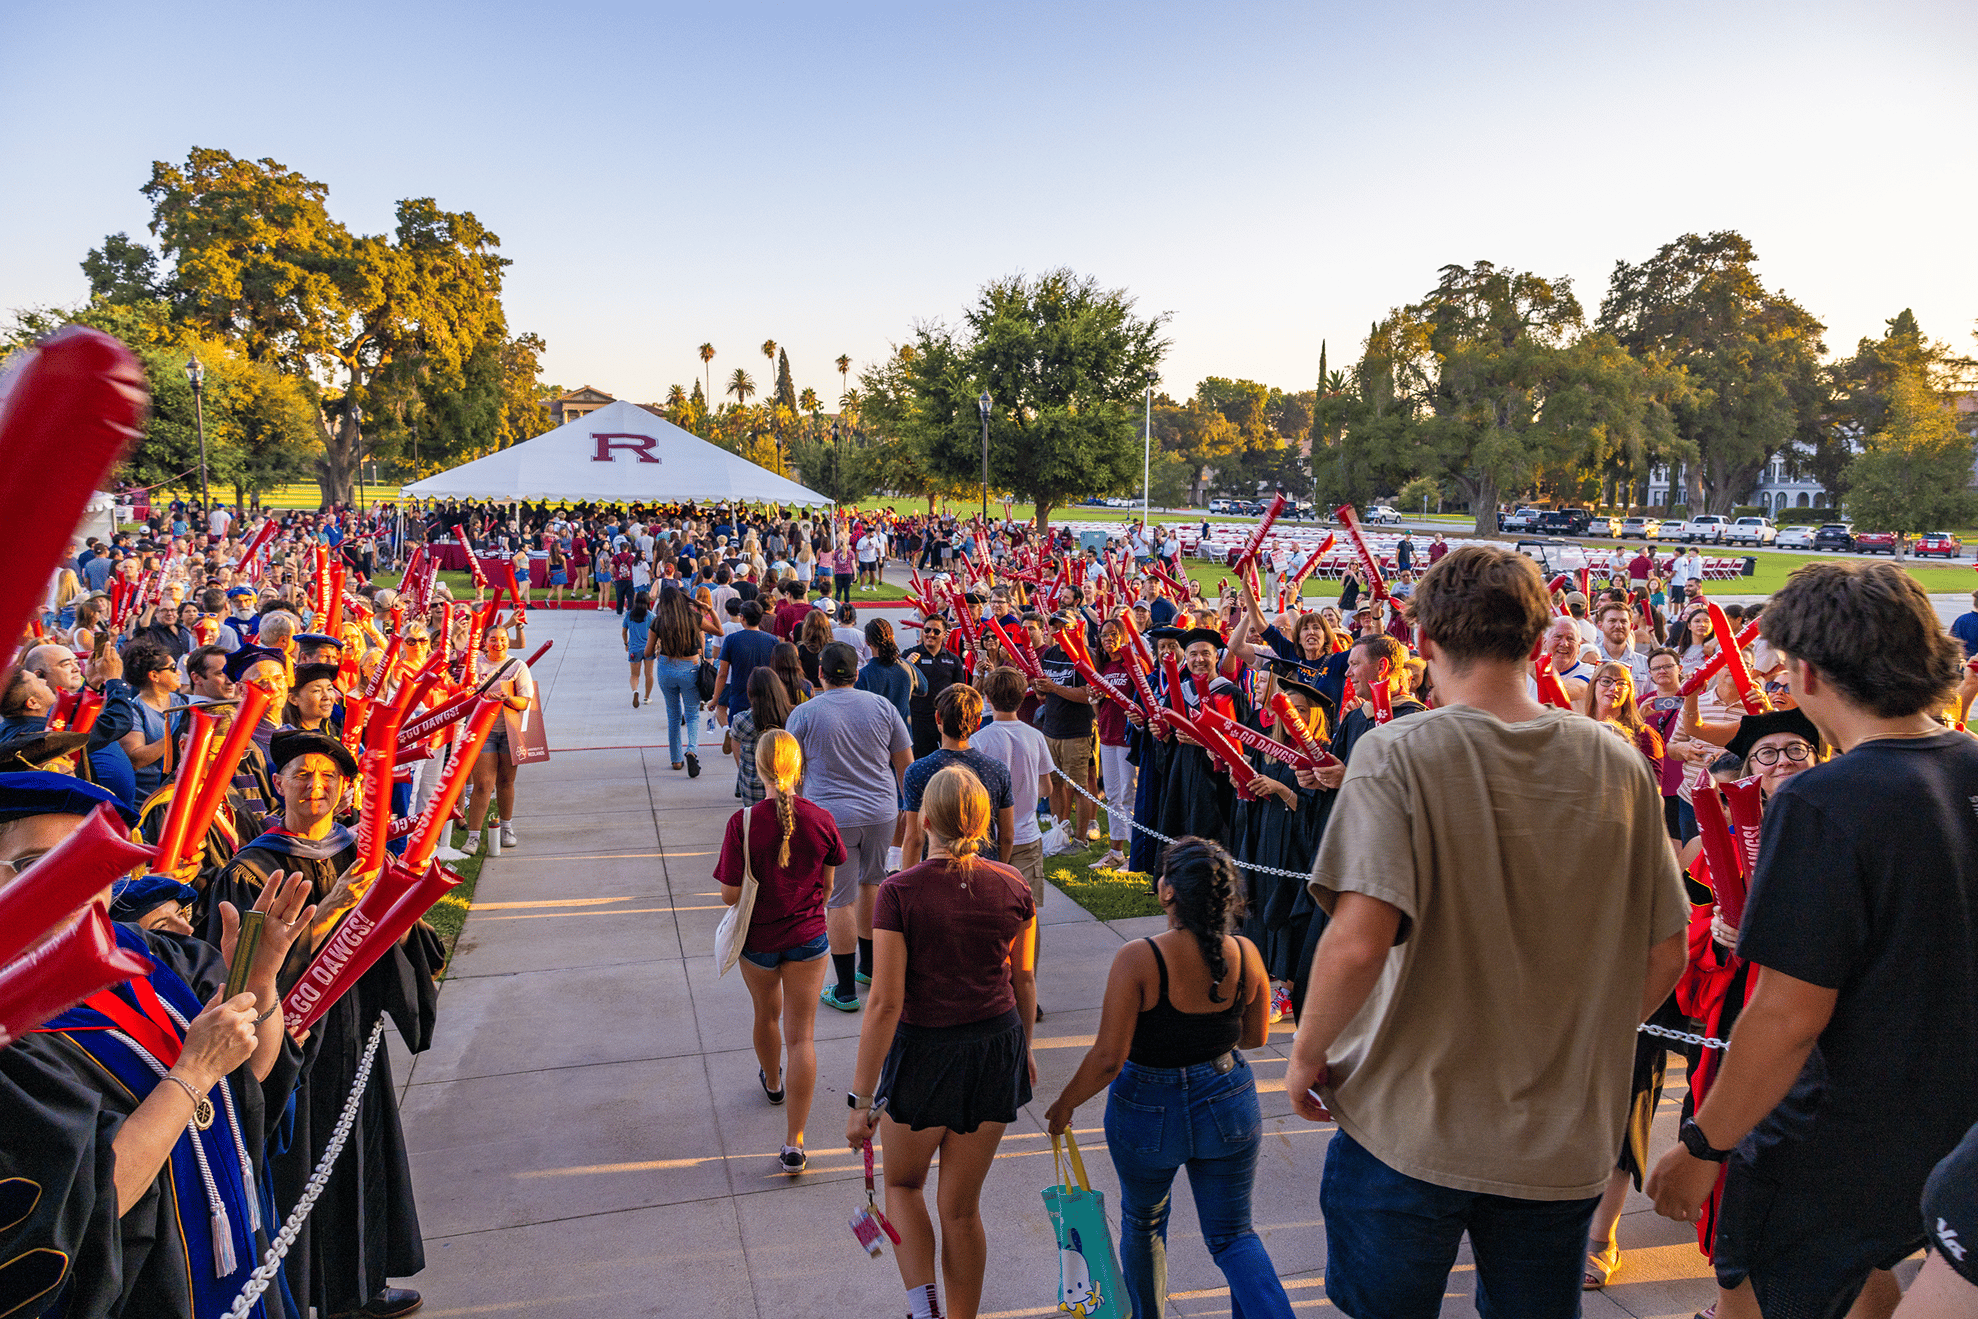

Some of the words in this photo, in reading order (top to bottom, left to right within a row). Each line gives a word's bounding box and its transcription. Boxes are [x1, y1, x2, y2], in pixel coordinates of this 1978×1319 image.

[589, 432, 662, 464] R
[365, 685, 376, 696] GO
[371, 655, 391, 686] DAWGS!
[1132, 663, 1153, 694] DAWGS!
[1146, 695, 1157, 706] GO
[406, 726, 421, 740] GO
[422, 706, 460, 733] DAWGS!
[1292, 718, 1305, 732] GO
[1301, 728, 1326, 762] DAWGS!
[1238, 731, 1257, 745] GO
[1255, 739, 1299, 765] DAWGS!
[442, 754, 460, 778] GO
[357, 795, 377, 857] DAWGS!
[411, 781, 449, 844] DAWGS!
[290, 981, 321, 1014] GO
[310, 909, 376, 986] DAWGS!
